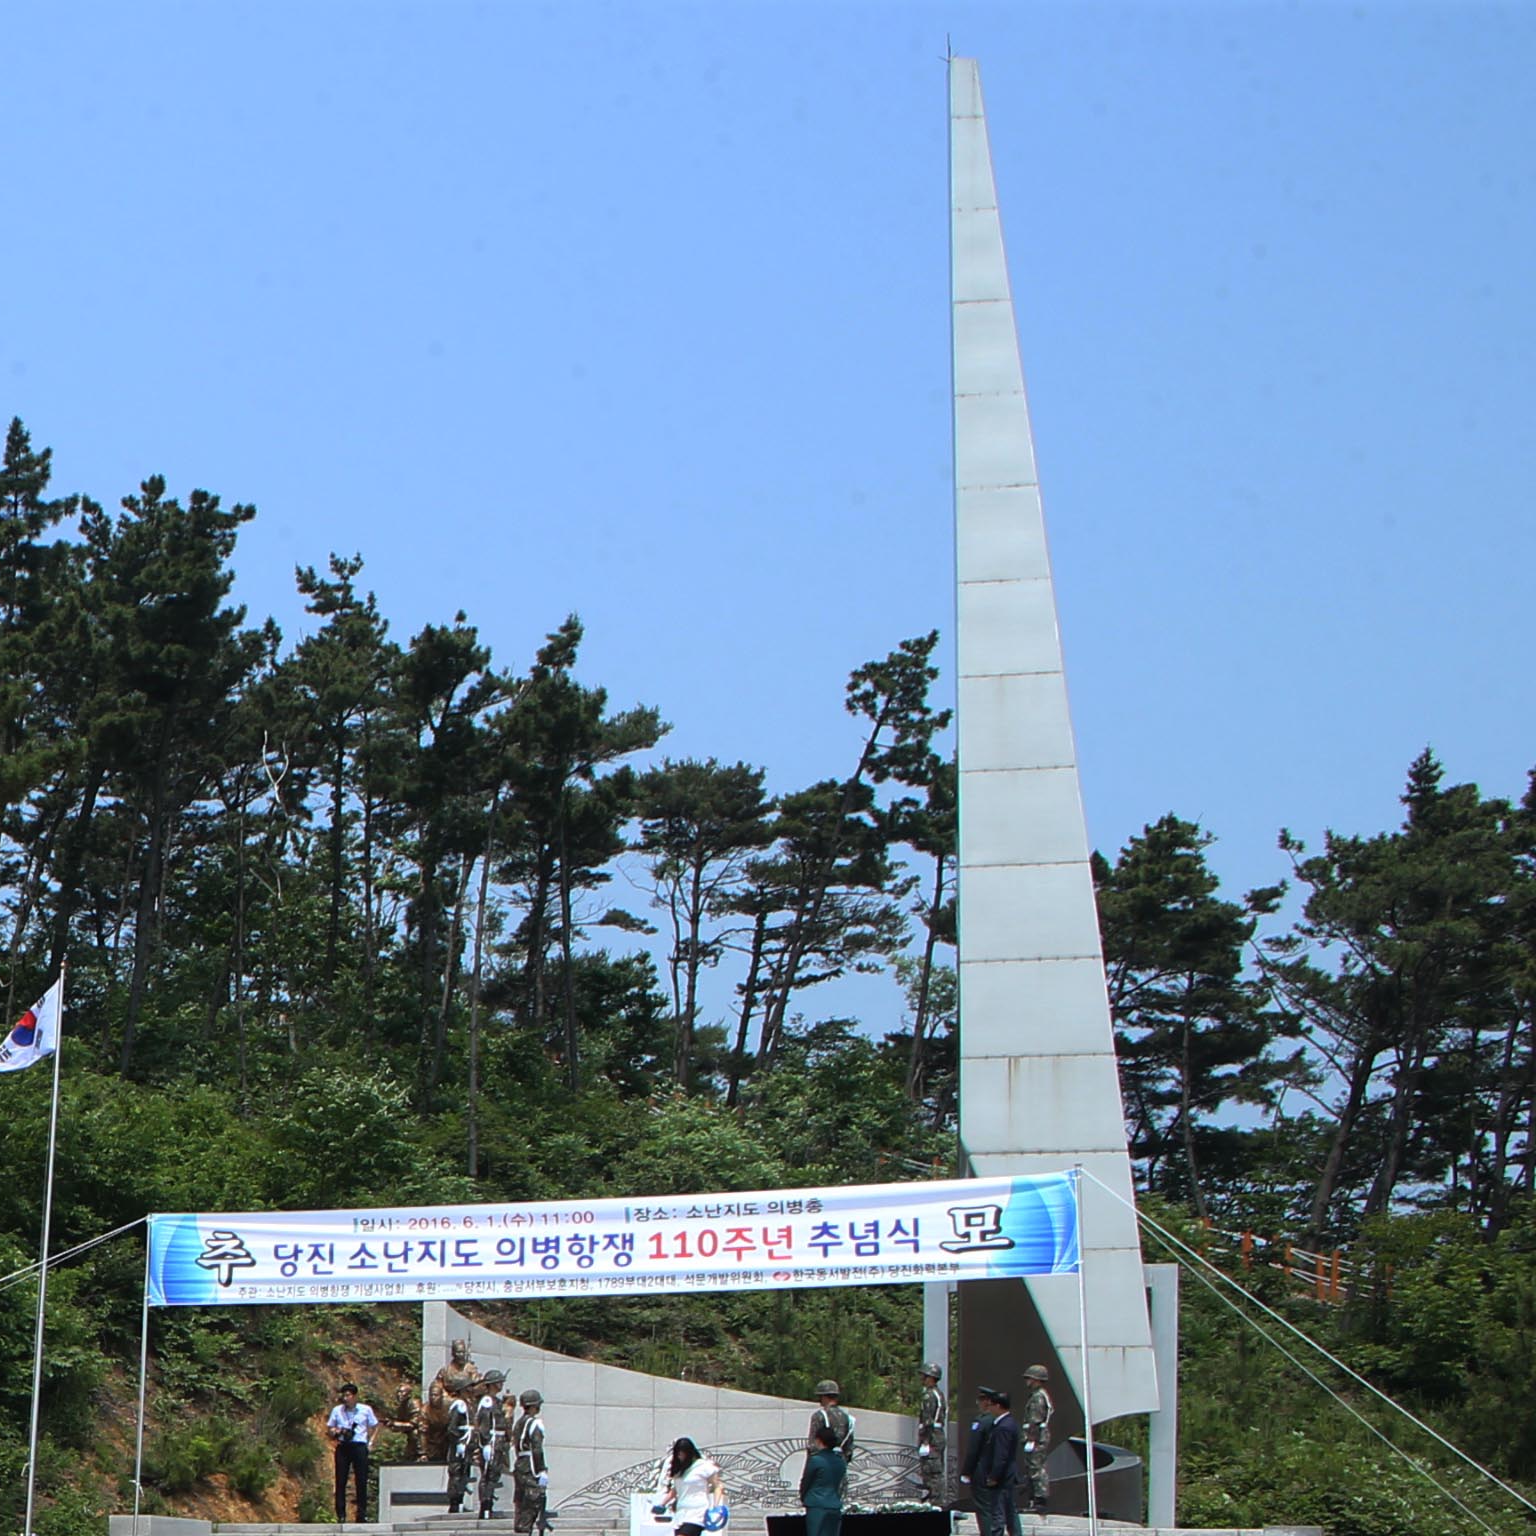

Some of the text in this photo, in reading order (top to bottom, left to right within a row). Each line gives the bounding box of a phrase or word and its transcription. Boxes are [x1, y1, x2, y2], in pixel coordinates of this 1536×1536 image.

[361, 1217, 400, 1233] 일시:
[408, 1216, 457, 1231] 2016.
[462, 1215, 479, 1229] 6.
[541, 1211, 594, 1225] 11:00
[634, 1207, 676, 1223] 장소:
[685, 1202, 761, 1220] 소난지도
[939, 1204, 1015, 1254] 모
[195, 1230, 257, 1288] 추
[274, 1218, 920, 1278] 당진 소난지도 의병항쟁 110주년 추념식
[237, 1282, 405, 1299] 주관: 소난지도 의병항쟁 기념사업회
[415, 1281, 441, 1295] 후원:
[464, 1279, 500, 1294] 당진시,
[793, 1264, 885, 1282] 한국동서발전(주)
[888, 1261, 961, 1277] 당진화력본부
